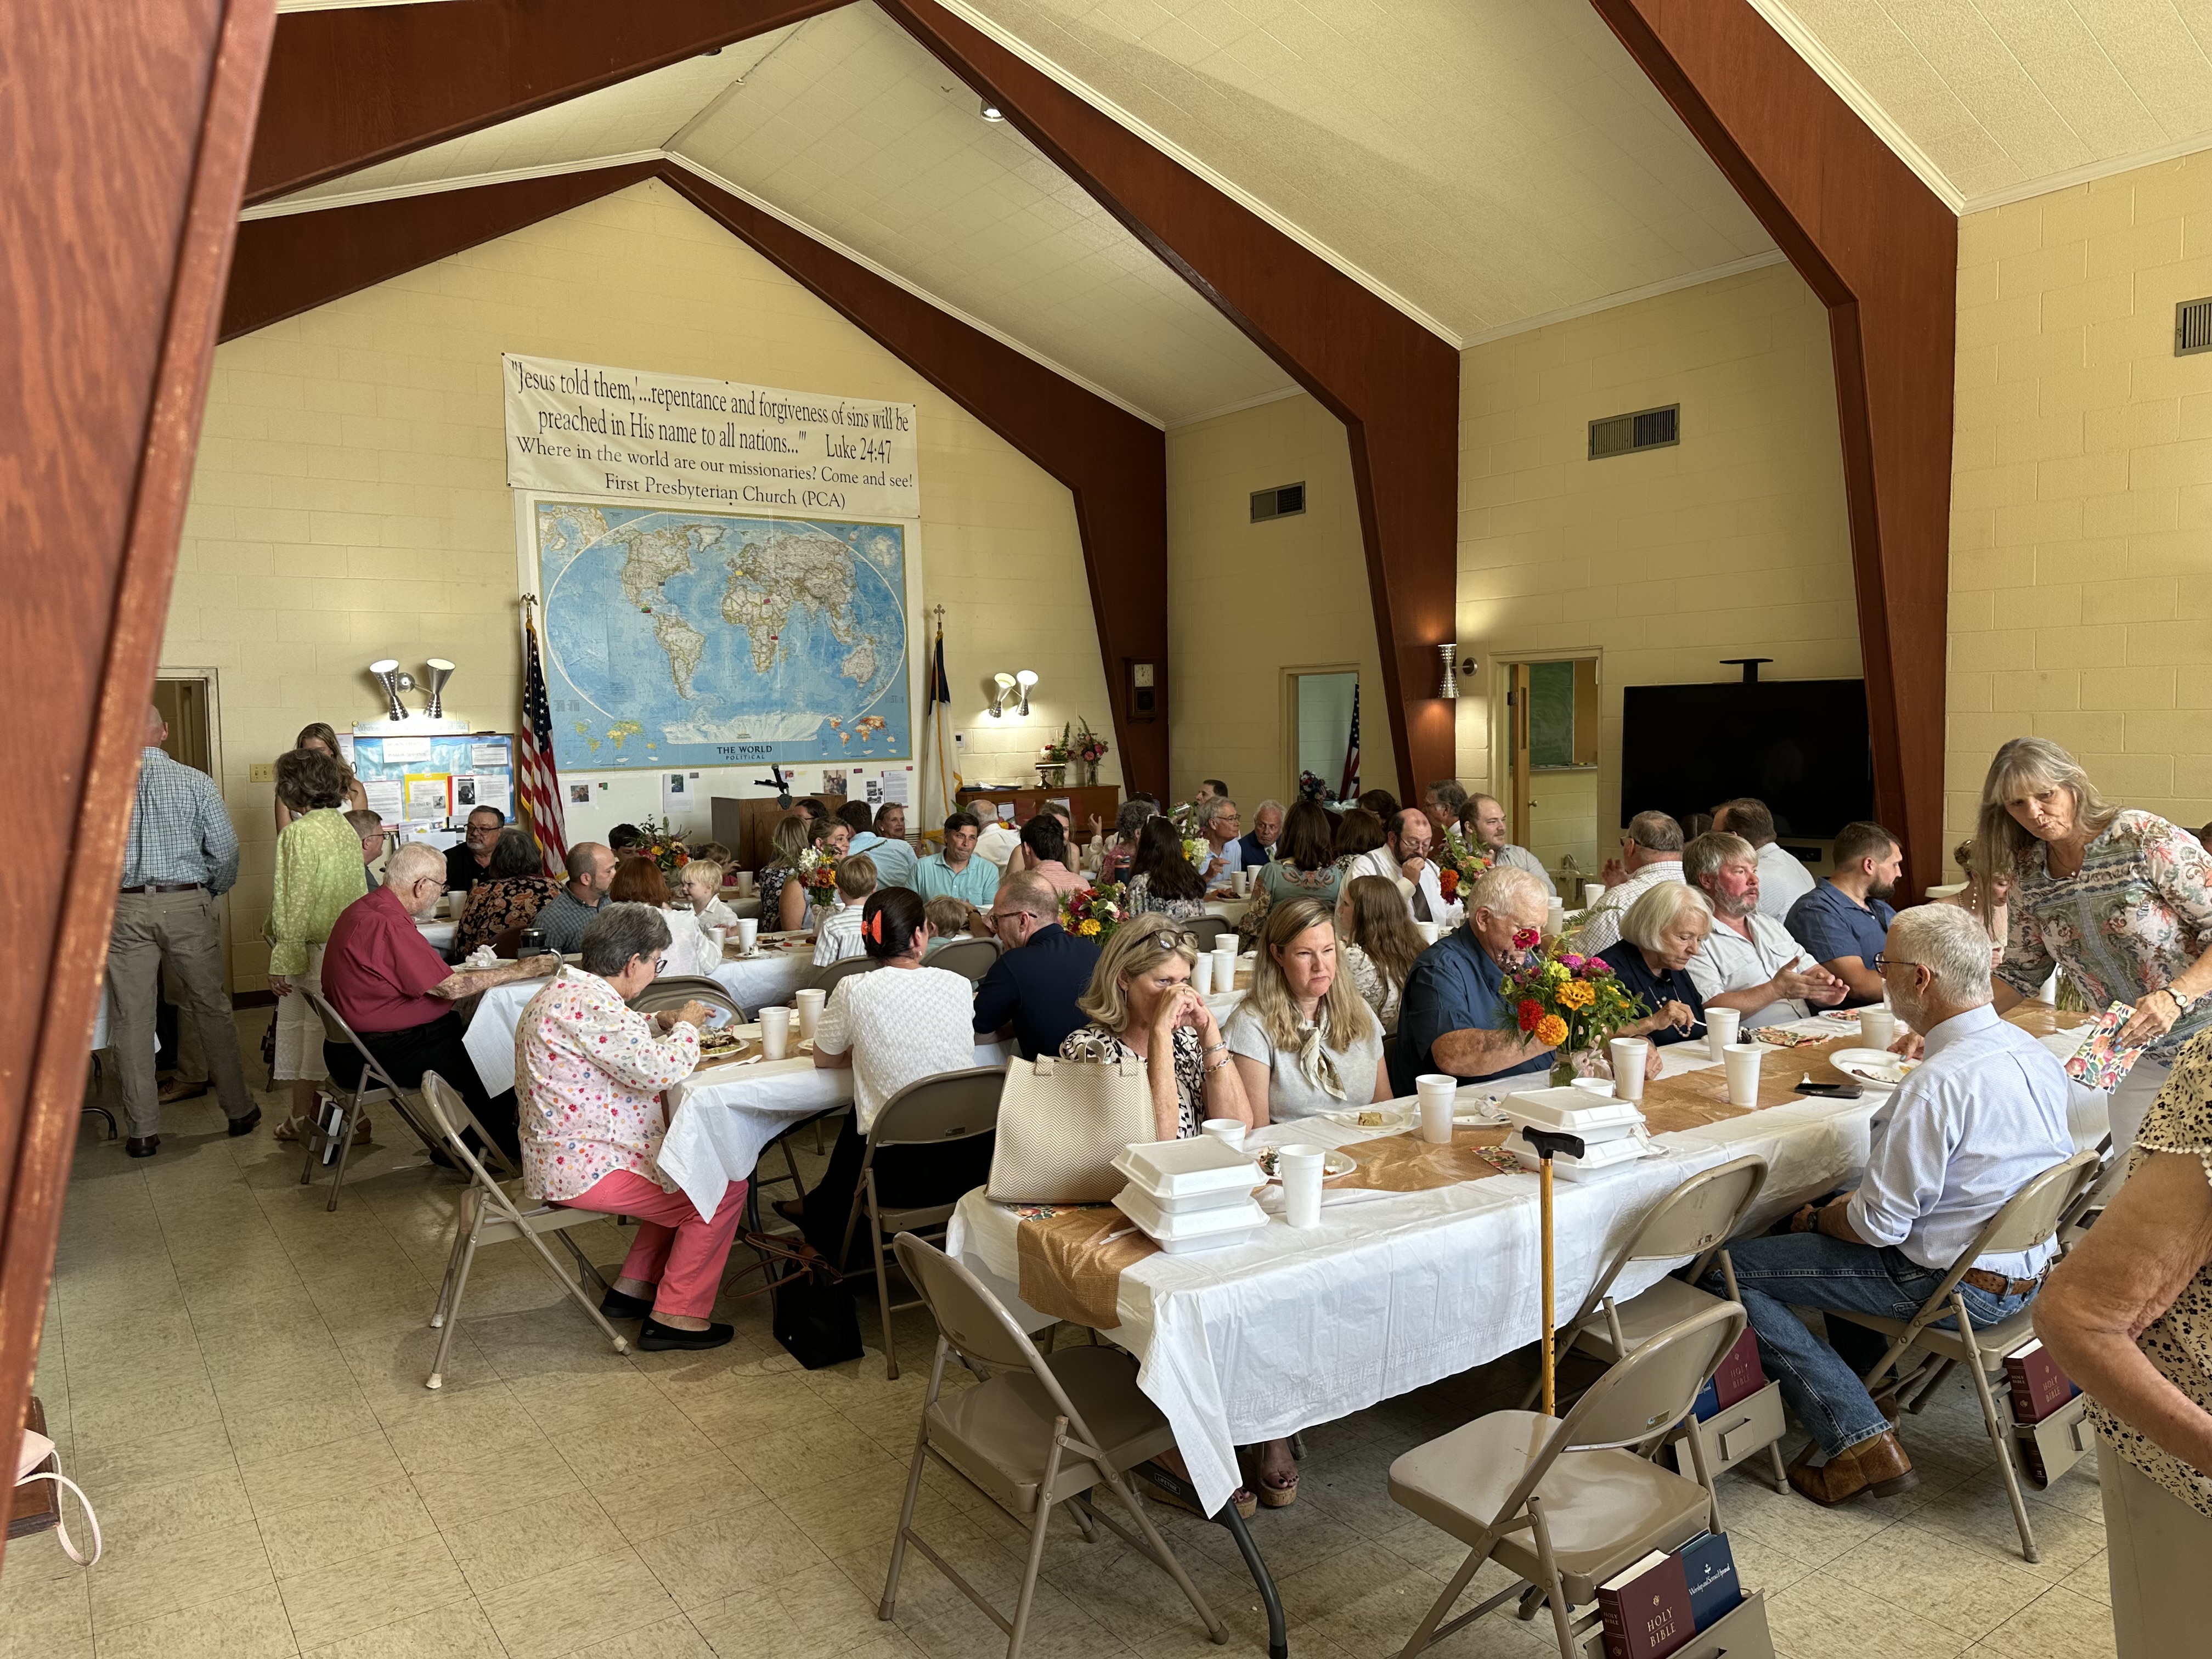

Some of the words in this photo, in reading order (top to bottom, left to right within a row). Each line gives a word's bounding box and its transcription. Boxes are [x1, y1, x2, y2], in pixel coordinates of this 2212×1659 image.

[511, 360, 555, 393] "Jesus
[560, 368, 589, 396] told
[731, 390, 755, 415] and
[759, 391, 828, 424] forgiveness
[831, 401, 845, 425] of
[847, 406, 868, 428] sins
[873, 407, 893, 430] will
[896, 408, 909, 431] be
[539, 405, 607, 435] preached
[611, 413, 626, 436] in
[630, 412, 654, 439] His
[658, 424, 697, 444] name
[702, 426, 715, 445] to
[719, 422, 735, 447] all
[826, 434, 856, 459] Luke
[860, 437, 891, 464] 24:47
[516, 436, 572, 457] Where
[577, 444, 591, 459] in
[597, 444, 622, 462] the
[627, 450, 669, 467] world
[674, 458, 696, 470] are
[701, 460, 724, 472] our
[729, 461, 816, 480] missionaries?
[821, 466, 859, 483] Come
[863, 471, 885, 486] and
[889, 473, 912, 487] see!
[605, 472, 640, 492] First
[645, 476, 738, 499] Presbyterian
[743, 486, 797, 504] Church
[802, 490, 845, 511] (PCA)
[738, 745, 772, 753] WORLD
[1730, 1363, 1748, 1378] HOLY
[1733, 1374, 1750, 1389] BIBLE
[2042, 1375, 2058, 1391] HOLY
[2045, 1386, 2061, 1403] BIBLE
[1647, 1607, 1673, 1632] HOLY
[1650, 1622, 1676, 1647] BIBLE
